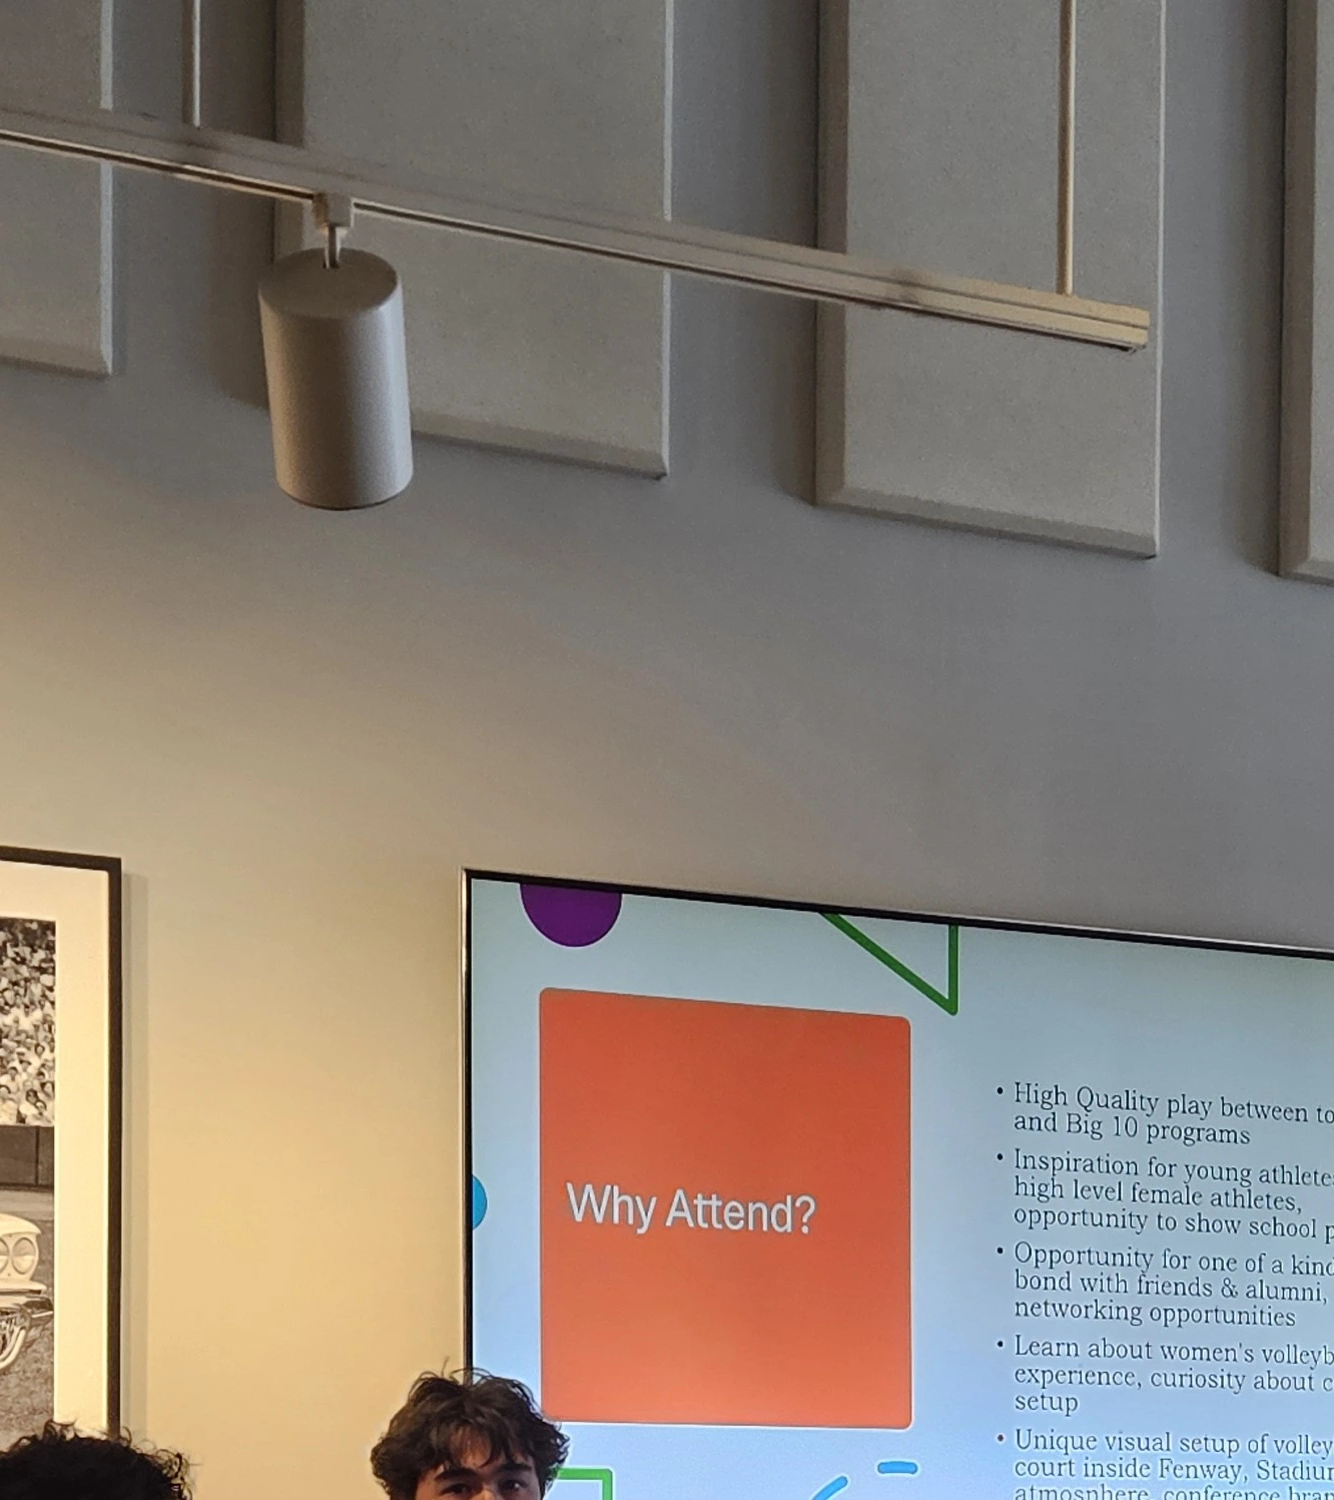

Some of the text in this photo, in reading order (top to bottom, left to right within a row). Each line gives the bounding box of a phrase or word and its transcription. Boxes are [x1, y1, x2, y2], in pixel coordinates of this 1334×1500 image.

[1014, 1082, 1068, 1107] High
[1077, 1086, 1159, 1113] Quality
[1167, 1094, 1212, 1120] play
[1220, 1097, 1308, 1122] between
[1014, 1112, 1251, 1146] and Big 10 programs
[1014, 1149, 1138, 1176] Inspiration
[1148, 1156, 1177, 1179] for
[1184, 1163, 1252, 1187] young
[566, 1182, 817, 1235] Why Attend?
[1014, 1177, 1302, 1214] high level female athletes,
[1014, 1208, 1148, 1235] opportunity
[1157, 1213, 1177, 1232] to
[1185, 1212, 1240, 1234] show
[1249, 1216, 1317, 1238] school
[1014, 1241, 1153, 1273] Opportunity
[1161, 1250, 1191, 1270] for
[1198, 1254, 1237, 1272] one
[1245, 1251, 1267, 1273] of
[1271, 1257, 1284, 1274] a
[1015, 1270, 1328, 1304] bond with friends & alumni,
[1014, 1300, 1295, 1328] networking opportunities
[1014, 1336, 1079, 1359] Learn
[1088, 1339, 1153, 1360] about
[1160, 1343, 1254, 1363] women's
[1014, 1365, 1142, 1390] experience,
[1150, 1369, 1246, 1393] curiosity
[1253, 1371, 1315, 1391] about
[1014, 1395, 1079, 1417] setup
[1015, 1429, 1097, 1455] Unique
[1105, 1432, 1171, 1452] visual
[1179, 1434, 1239, 1459] setup
[1248, 1434, 1268, 1454] of
[1014, 1458, 1075, 1478] court
[1083, 1458, 1150, 1479] inside
[1159, 1459, 1249, 1484] Fenway,
